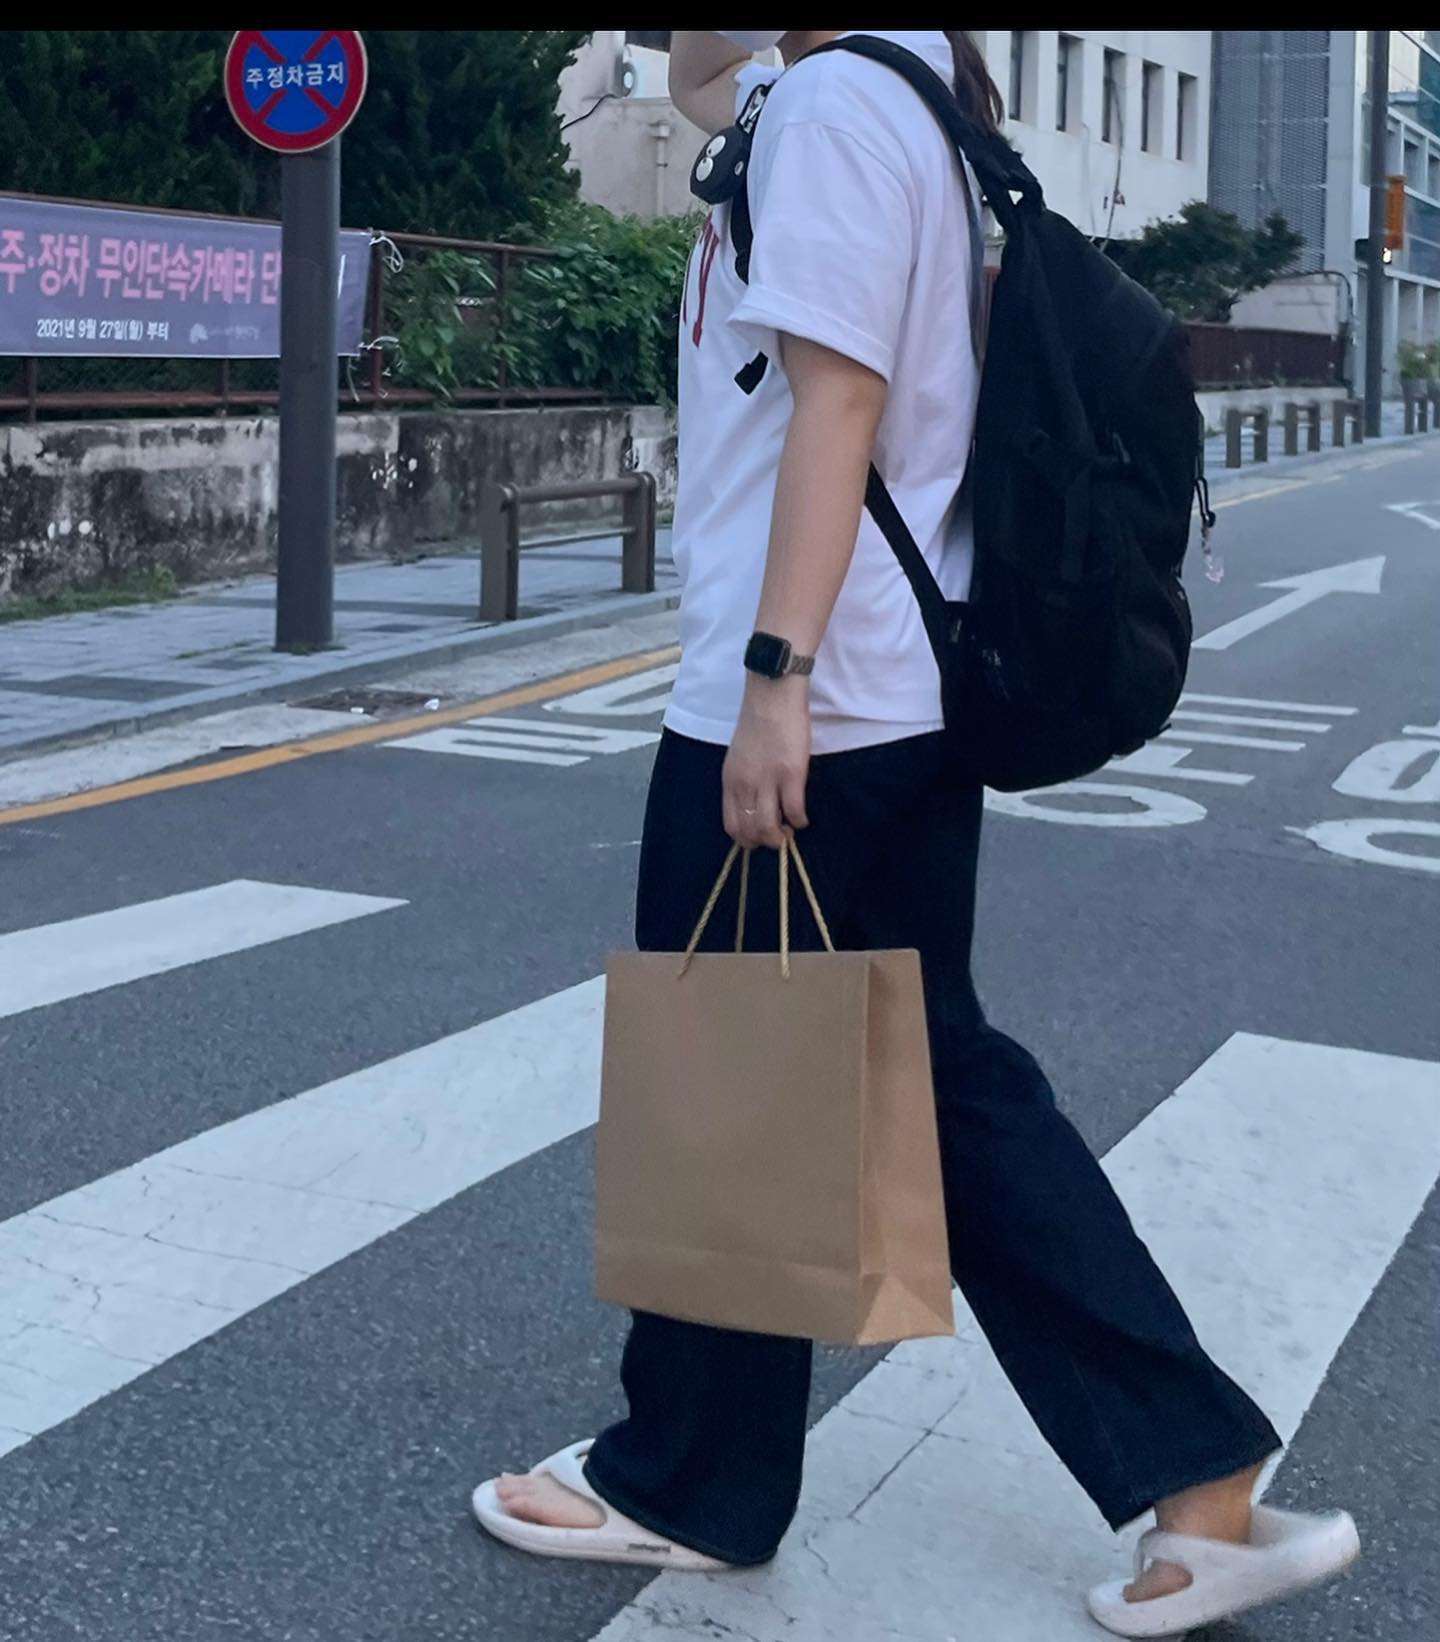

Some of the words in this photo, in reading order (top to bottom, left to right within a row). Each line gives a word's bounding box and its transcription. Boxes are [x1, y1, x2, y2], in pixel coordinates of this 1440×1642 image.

[246, 62, 344, 90] 주정차금지
[96, 238, 255, 304] 무인단속카메라
[37, 318, 75, 338] 2021년
[79, 318, 96, 339] 9월
[99, 320, 143, 340] 27일(월)
[147, 321, 168, 340] 부터
